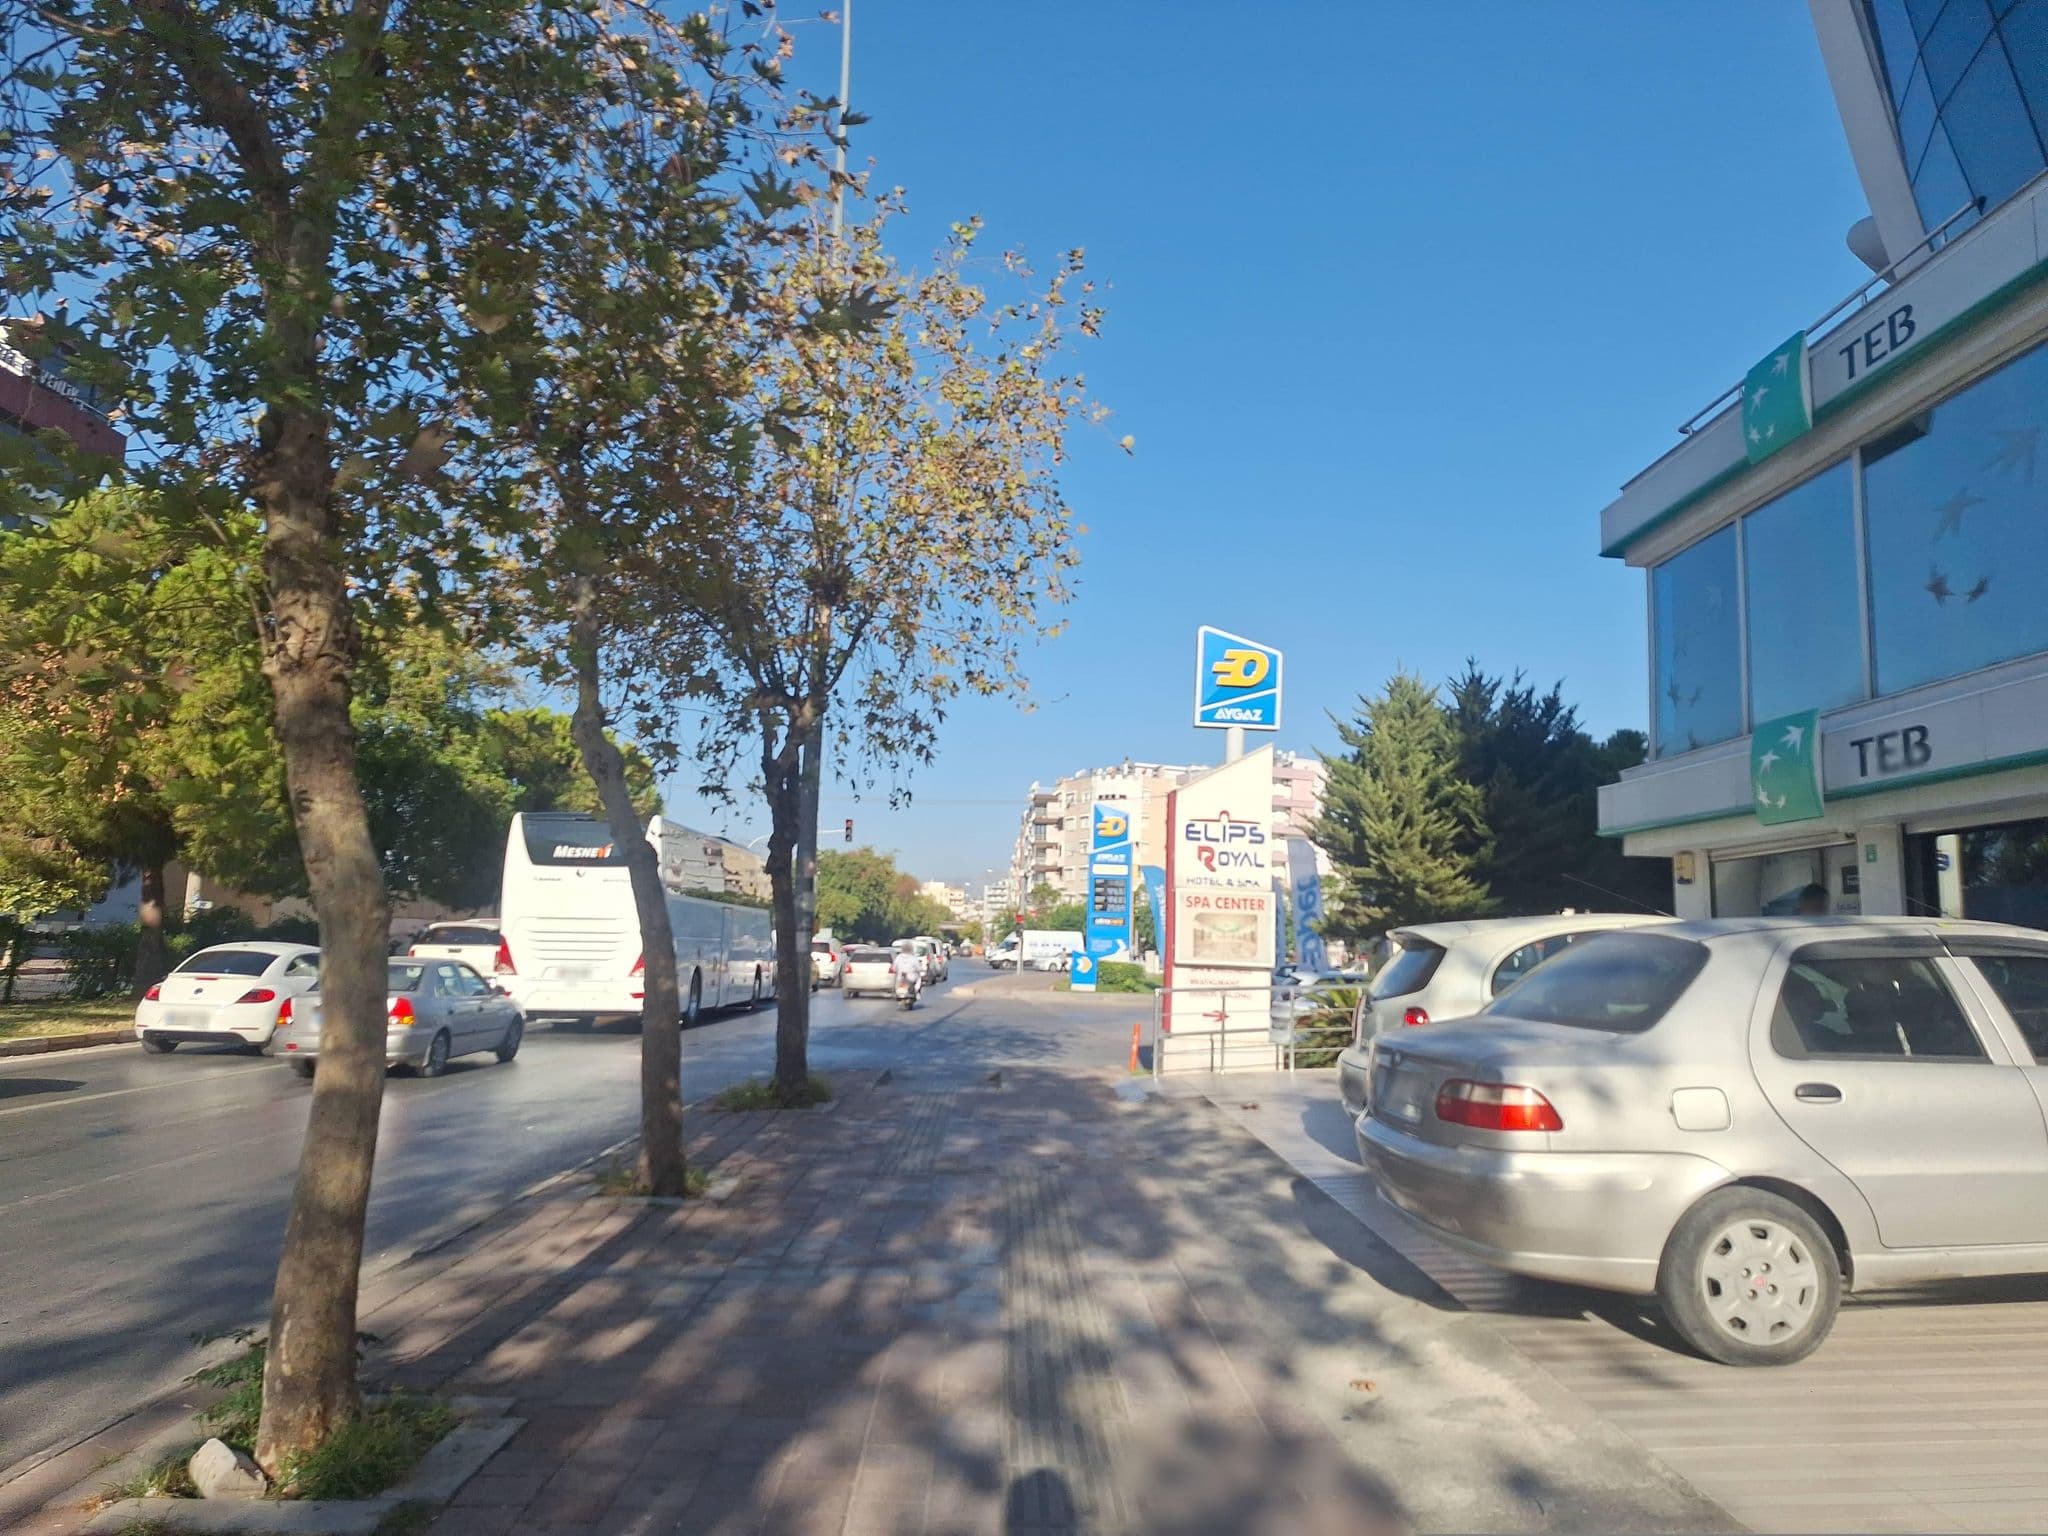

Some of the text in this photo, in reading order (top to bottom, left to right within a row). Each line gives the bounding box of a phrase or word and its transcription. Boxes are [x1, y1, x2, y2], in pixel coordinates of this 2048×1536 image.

[1839, 304, 1916, 380] TEB
[1213, 707, 1264, 721] AYGAZ
[1850, 725, 1932, 777] TEB
[1185, 823, 1265, 844] ELIPS
[1197, 846, 1264, 872] ROYAL
[1185, 896, 1265, 910] SPA CENTER
